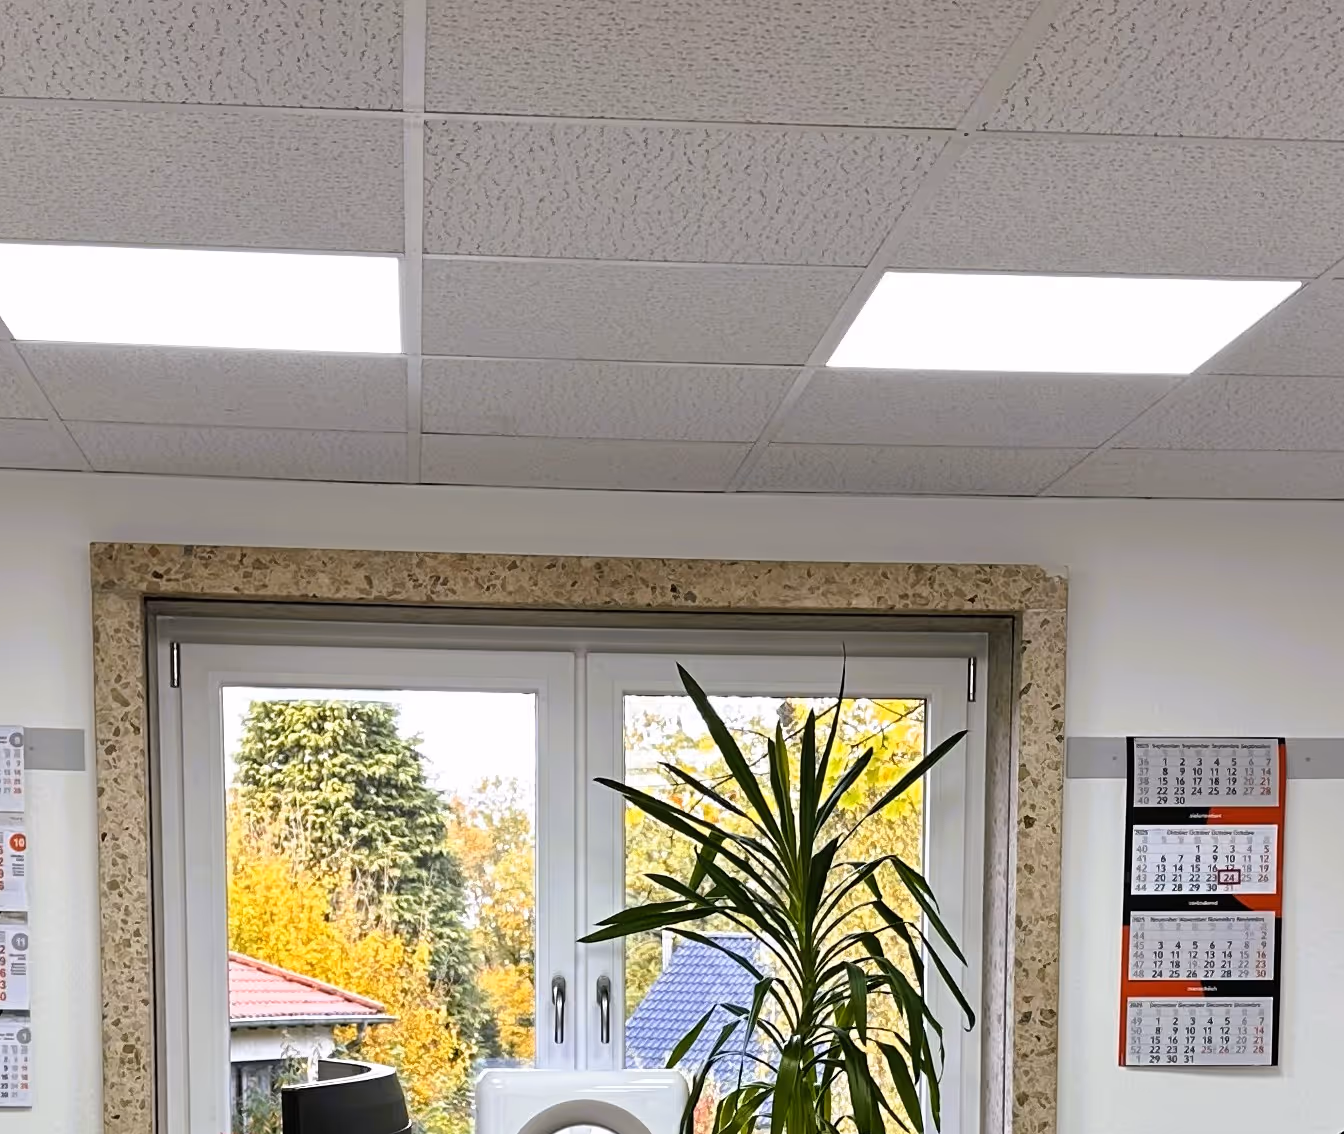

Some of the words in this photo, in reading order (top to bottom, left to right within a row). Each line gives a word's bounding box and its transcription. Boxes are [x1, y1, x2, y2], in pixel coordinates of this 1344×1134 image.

[1163, 758, 1167, 766] 1
[1180, 758, 1185, 766] 2
[1197, 758, 1202, 766] 3
[1214, 758, 1220, 766] 4
[1231, 758, 1237, 766] 5
[1162, 767, 1168, 776] 8
[1180, 767, 1185, 776] 9
[1192, 767, 1202, 776] 10
[1210, 768, 1219, 776] 11
[1227, 768, 1237, 776] 12
[1158, 777, 1168, 785] 15
[1176, 777, 1185, 785] 16
[1193, 777, 1202, 785] 17
[1209, 777, 1220, 785] 18
[1227, 777, 1237, 785] 19
[1157, 787, 1168, 795] 22
[1174, 787, 1185, 795] 23
[1191, 787, 1202, 795] 24
[1208, 787, 1219, 795] 25
[1226, 787, 1237, 795] 26
[1157, 796, 1168, 804] 29
[1174, 796, 1185, 805] 30
[13, 838, 25, 848] 10
[1196, 845, 1200, 853] 1
[1213, 845, 1218, 853] 2
[1230, 845, 1235, 853] 3
[1264, 845, 1269, 853] 5
[1161, 855, 1166, 863] 6
[1178, 855, 1183, 863] 7
[1195, 855, 1201, 863] 8
[1212, 855, 1218, 863] 9
[1225, 854, 1235, 863] 10
[1156, 864, 1166, 873] 13
[1173, 864, 1183, 872] 14
[1191, 864, 1200, 873] 15
[1259, 864, 1269, 873] 19
[1154, 874, 1166, 882] 20
[1172, 874, 1182, 882] 21
[1189, 873, 1200, 882] 22
[1154, 883, 1166, 891] 27
[1172, 883, 1183, 892] 28
[1189, 883, 1200, 891] 29
[1206, 883, 1217, 892] 30
[16, 938, 26, 947] 11
[1158, 941, 1163, 950] 3
[1175, 941, 1181, 949] 4
[1193, 941, 1198, 950] 5
[1210, 941, 1215, 949] 6
[1227, 941, 1232, 949] 7
[0, 945, 5, 954] 2
[1153, 951, 1163, 959] 10
[1171, 951, 1179, 959] 11
[1188, 951, 1198, 959] 12
[1205, 951, 1215, 959] 13
[1222, 951, 1232, 959] 14
[0, 956, 6, 966] 9
[1153, 960, 1163, 968] 17
[1170, 960, 1180, 969] 18
[1204, 960, 1215, 968] 20
[1221, 960, 1231, 968] 21
[1152, 970, 1163, 978] 24
[1169, 970, 1180, 978] 25
[1186, 970, 1197, 978] 26
[1203, 970, 1215, 978] 27
[1221, 969, 1232, 978] 28
[1156, 1017, 1160, 1025] 1
[1173, 1017, 1178, 1026] 2
[1190, 1017, 1196, 1026] 3
[1207, 1017, 1213, 1025] 4
[1225, 1017, 1230, 1025] 5
[1155, 1027, 1161, 1035] 8
[1173, 1027, 1178, 1035] 9
[1185, 1027, 1195, 1035] 10
[1220, 1027, 1230, 1035] 12
[1150, 1036, 1160, 1044] 15
[1168, 1036, 1178, 1044] 16
[1185, 1036, 1195, 1044] 17
[1203, 1036, 1212, 1044] 18
[1220, 1036, 1230, 1044] 19
[1149, 1046, 1160, 1054] 22
[1166, 1046, 1177, 1054] 23
[1184, 1046, 1195, 1054] 24
[1149, 1055, 1160, 1063] 29
[1167, 1055, 1178, 1063] 30
[1184, 1055, 1194, 1063] 31
